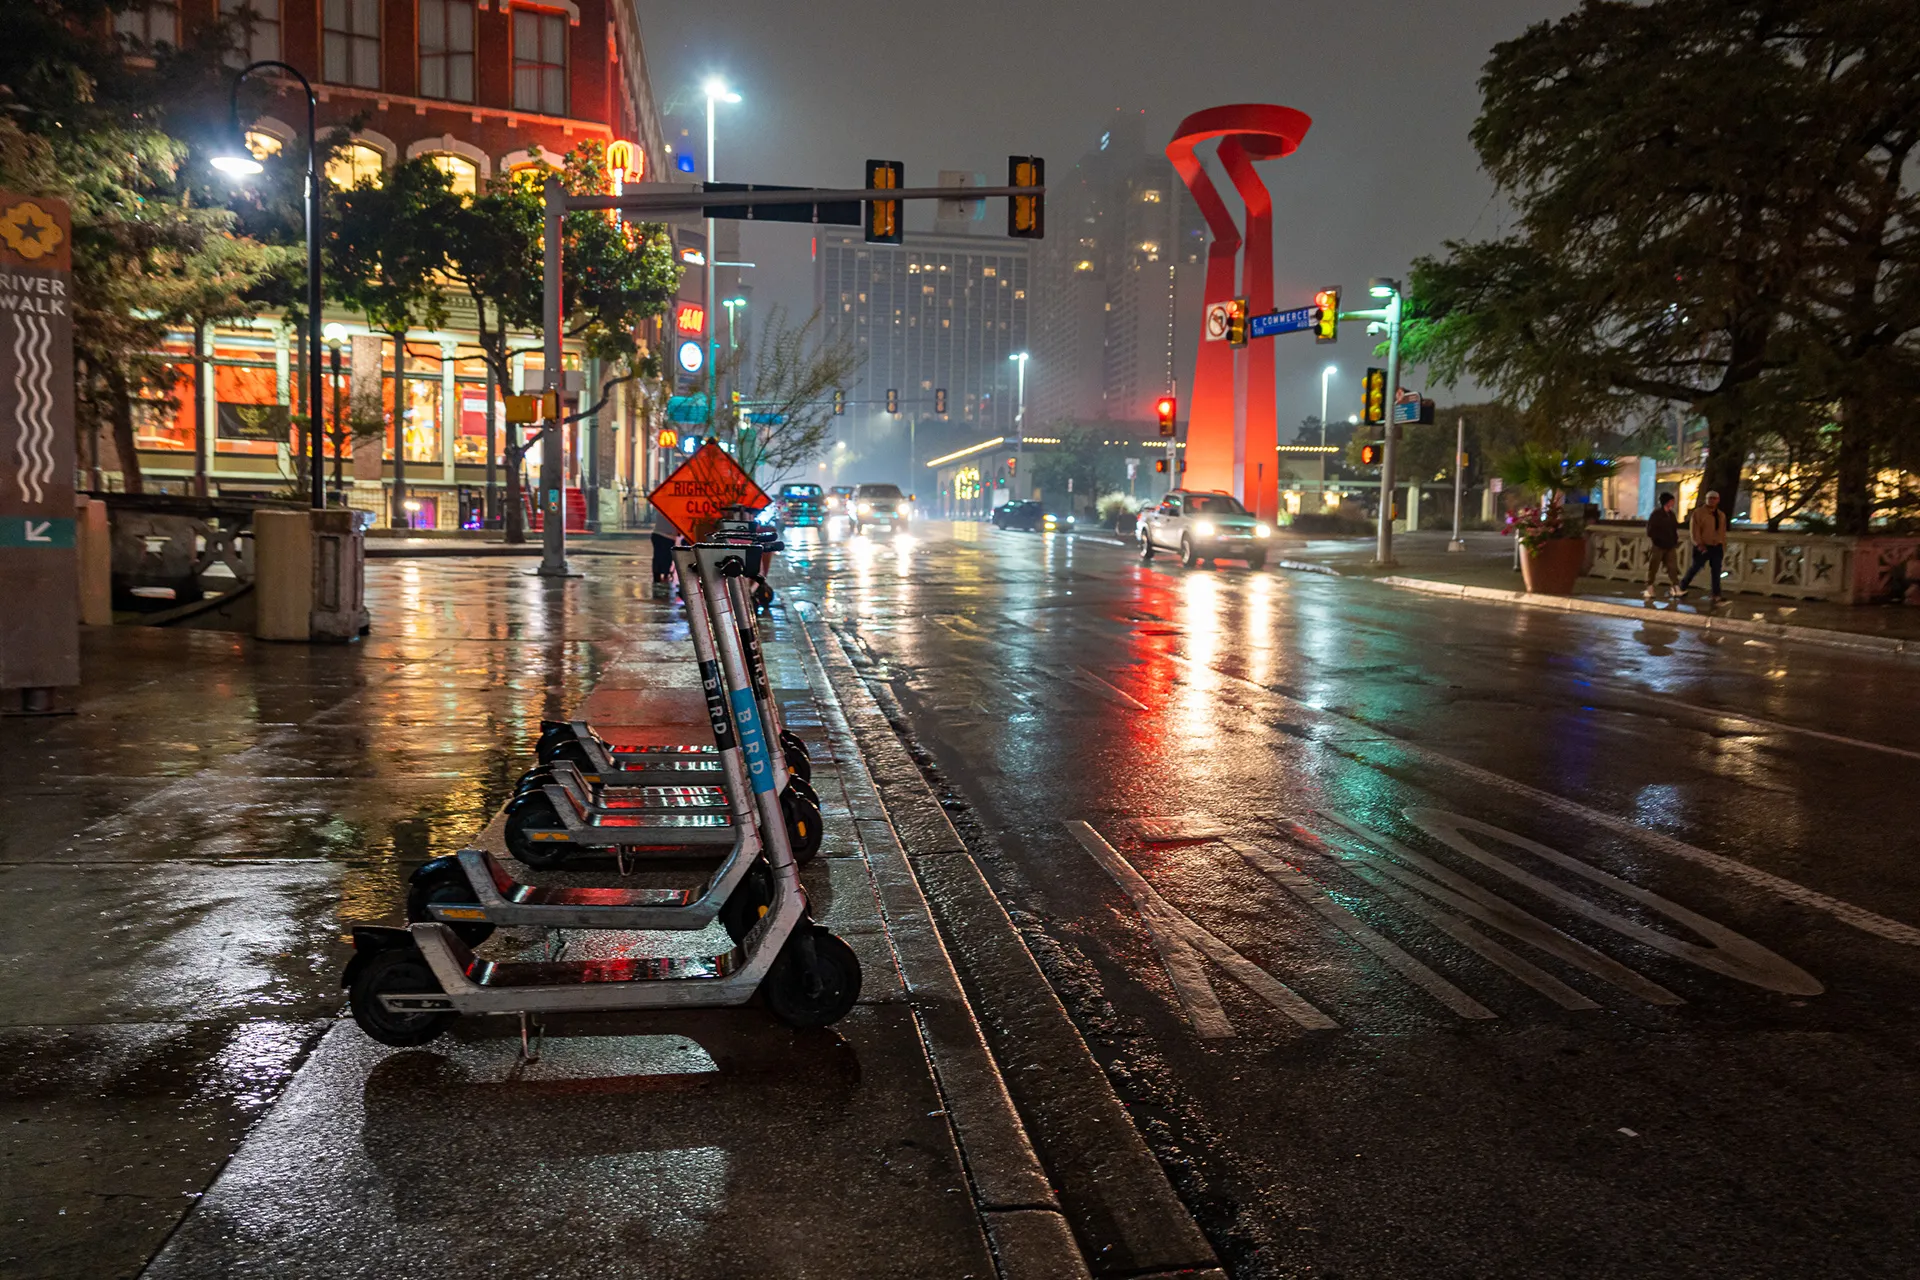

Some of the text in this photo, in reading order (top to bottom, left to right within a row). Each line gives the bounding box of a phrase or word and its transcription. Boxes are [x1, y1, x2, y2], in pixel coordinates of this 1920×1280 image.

[0, 273, 66, 296] RIVER
[0, 294, 66, 316] WALK
[1253, 310, 1308, 328] E COMMERCE
[674, 482, 748, 496] RIGHT LANE
[703, 677, 727, 735] BIRD
[738, 707, 765, 775] BIRD
